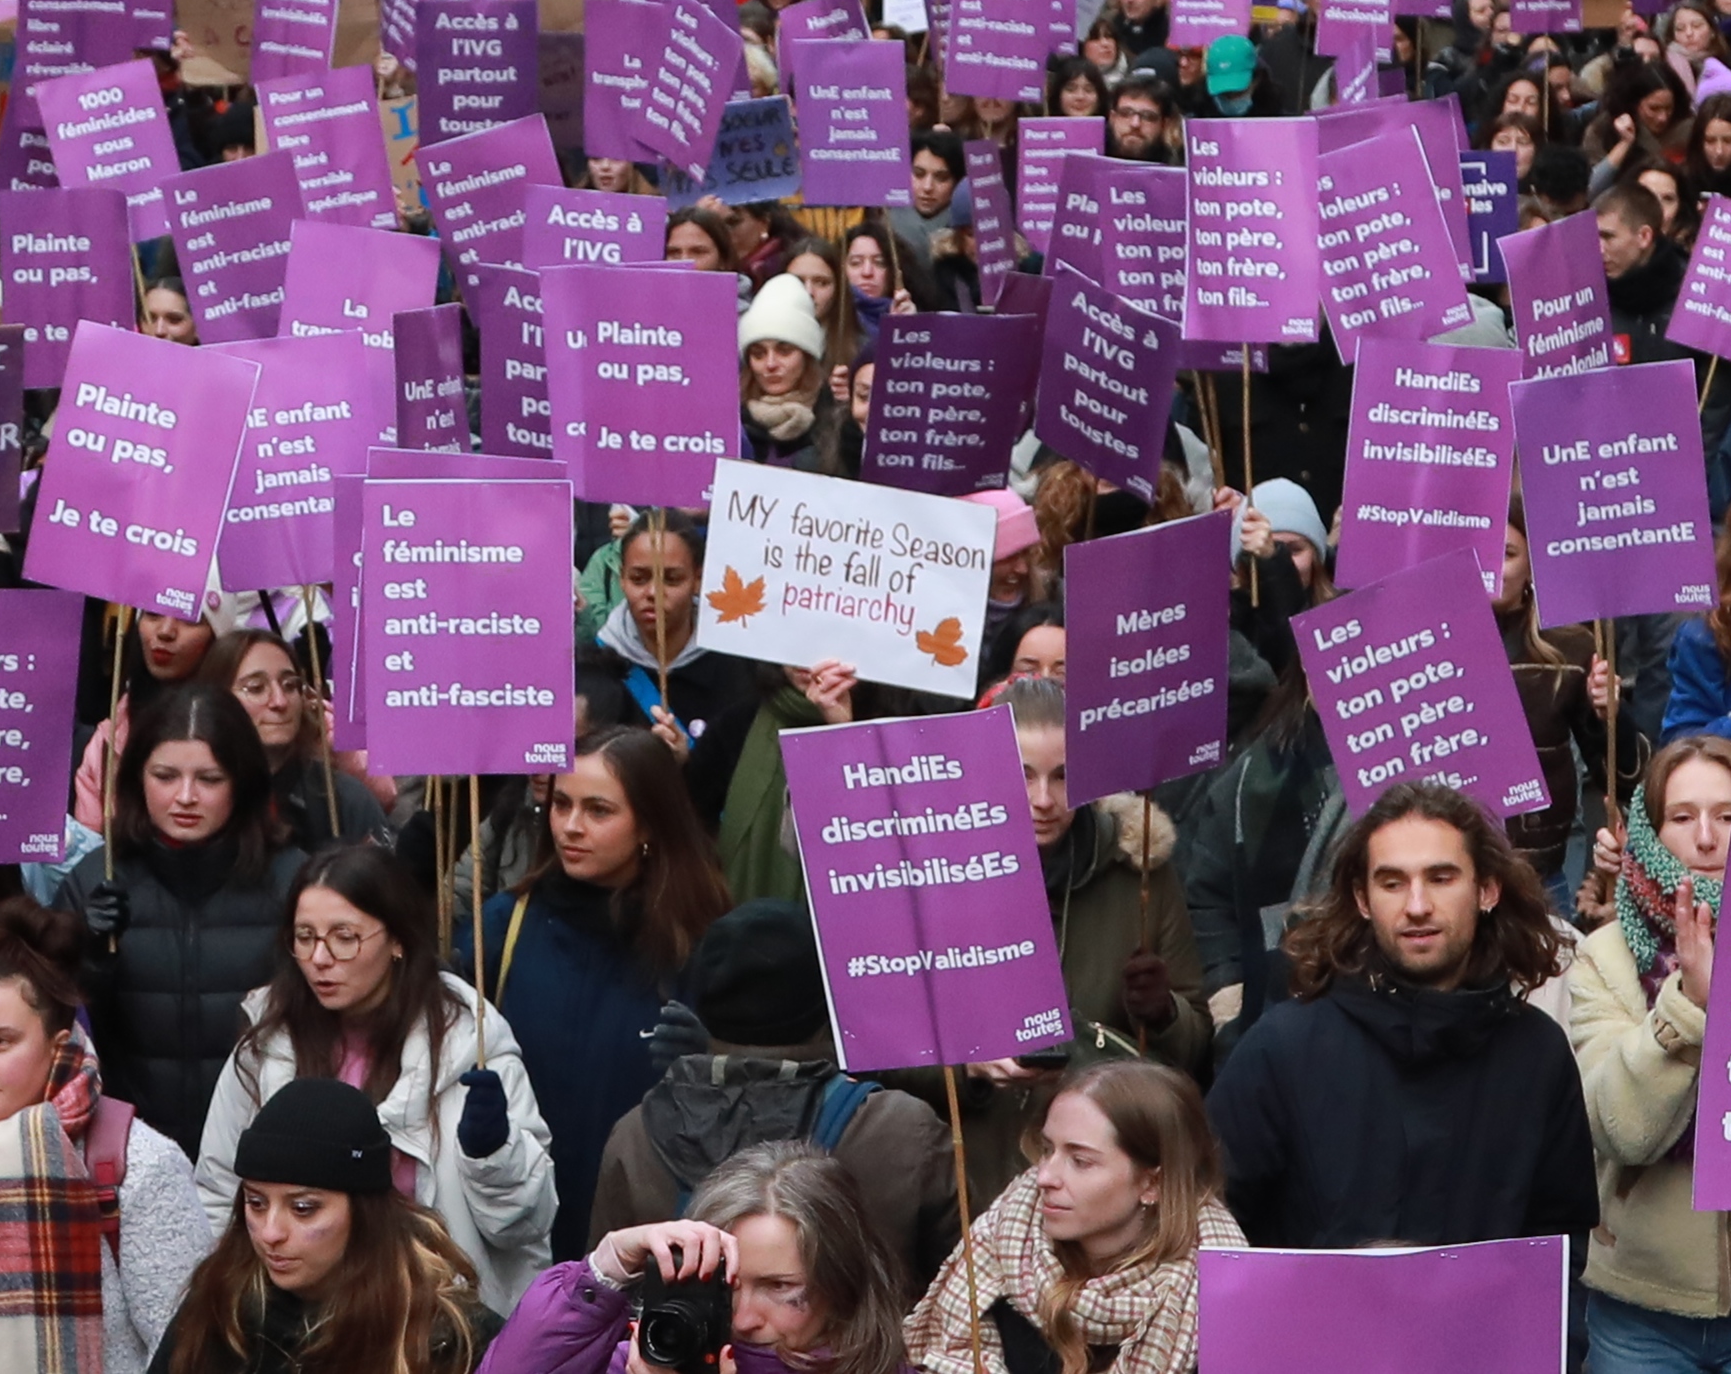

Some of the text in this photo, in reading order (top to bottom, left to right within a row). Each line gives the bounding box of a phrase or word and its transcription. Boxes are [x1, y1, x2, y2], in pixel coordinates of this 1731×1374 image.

[78, 88, 122, 110] 1000
[810, 86, 892, 100] UnE enfant
[58, 107, 156, 139] féminicides
[829, 126, 877, 142] jamais
[93, 137, 133, 155] sous
[810, 148, 900, 161] consentantE
[87, 157, 151, 181] Macron
[1715, 208, 1731, 223] Le
[1703, 247, 1724, 261] est
[1691, 282, 1705, 294] et
[1543, 434, 1677, 464] UnE enfant
[384, 505, 415, 526] Le
[1577, 495, 1655, 526] jamais
[790, 502, 884, 549] favorite
[890, 523, 986, 570] Season
[1547, 521, 1695, 556] consentantE
[383, 540, 522, 562] féminisme
[764, 538, 924, 594] is the fall of
[384, 579, 426, 598] est
[783, 582, 915, 636] patriarchy
[1117, 604, 1185, 635] Mères
[385, 612, 540, 634] anti-raciste
[386, 651, 413, 670] et
[1110, 645, 1189, 677] isolées
[386, 683, 554, 706] anti-fasciste
[1080, 678, 1214, 731] précarisées
[844, 755, 962, 789] HandiEs
[822, 802, 1007, 843] discriminéEs
[829, 852, 1018, 894] invisibiliséEs
[848, 941, 1034, 977] #StopValidisme
